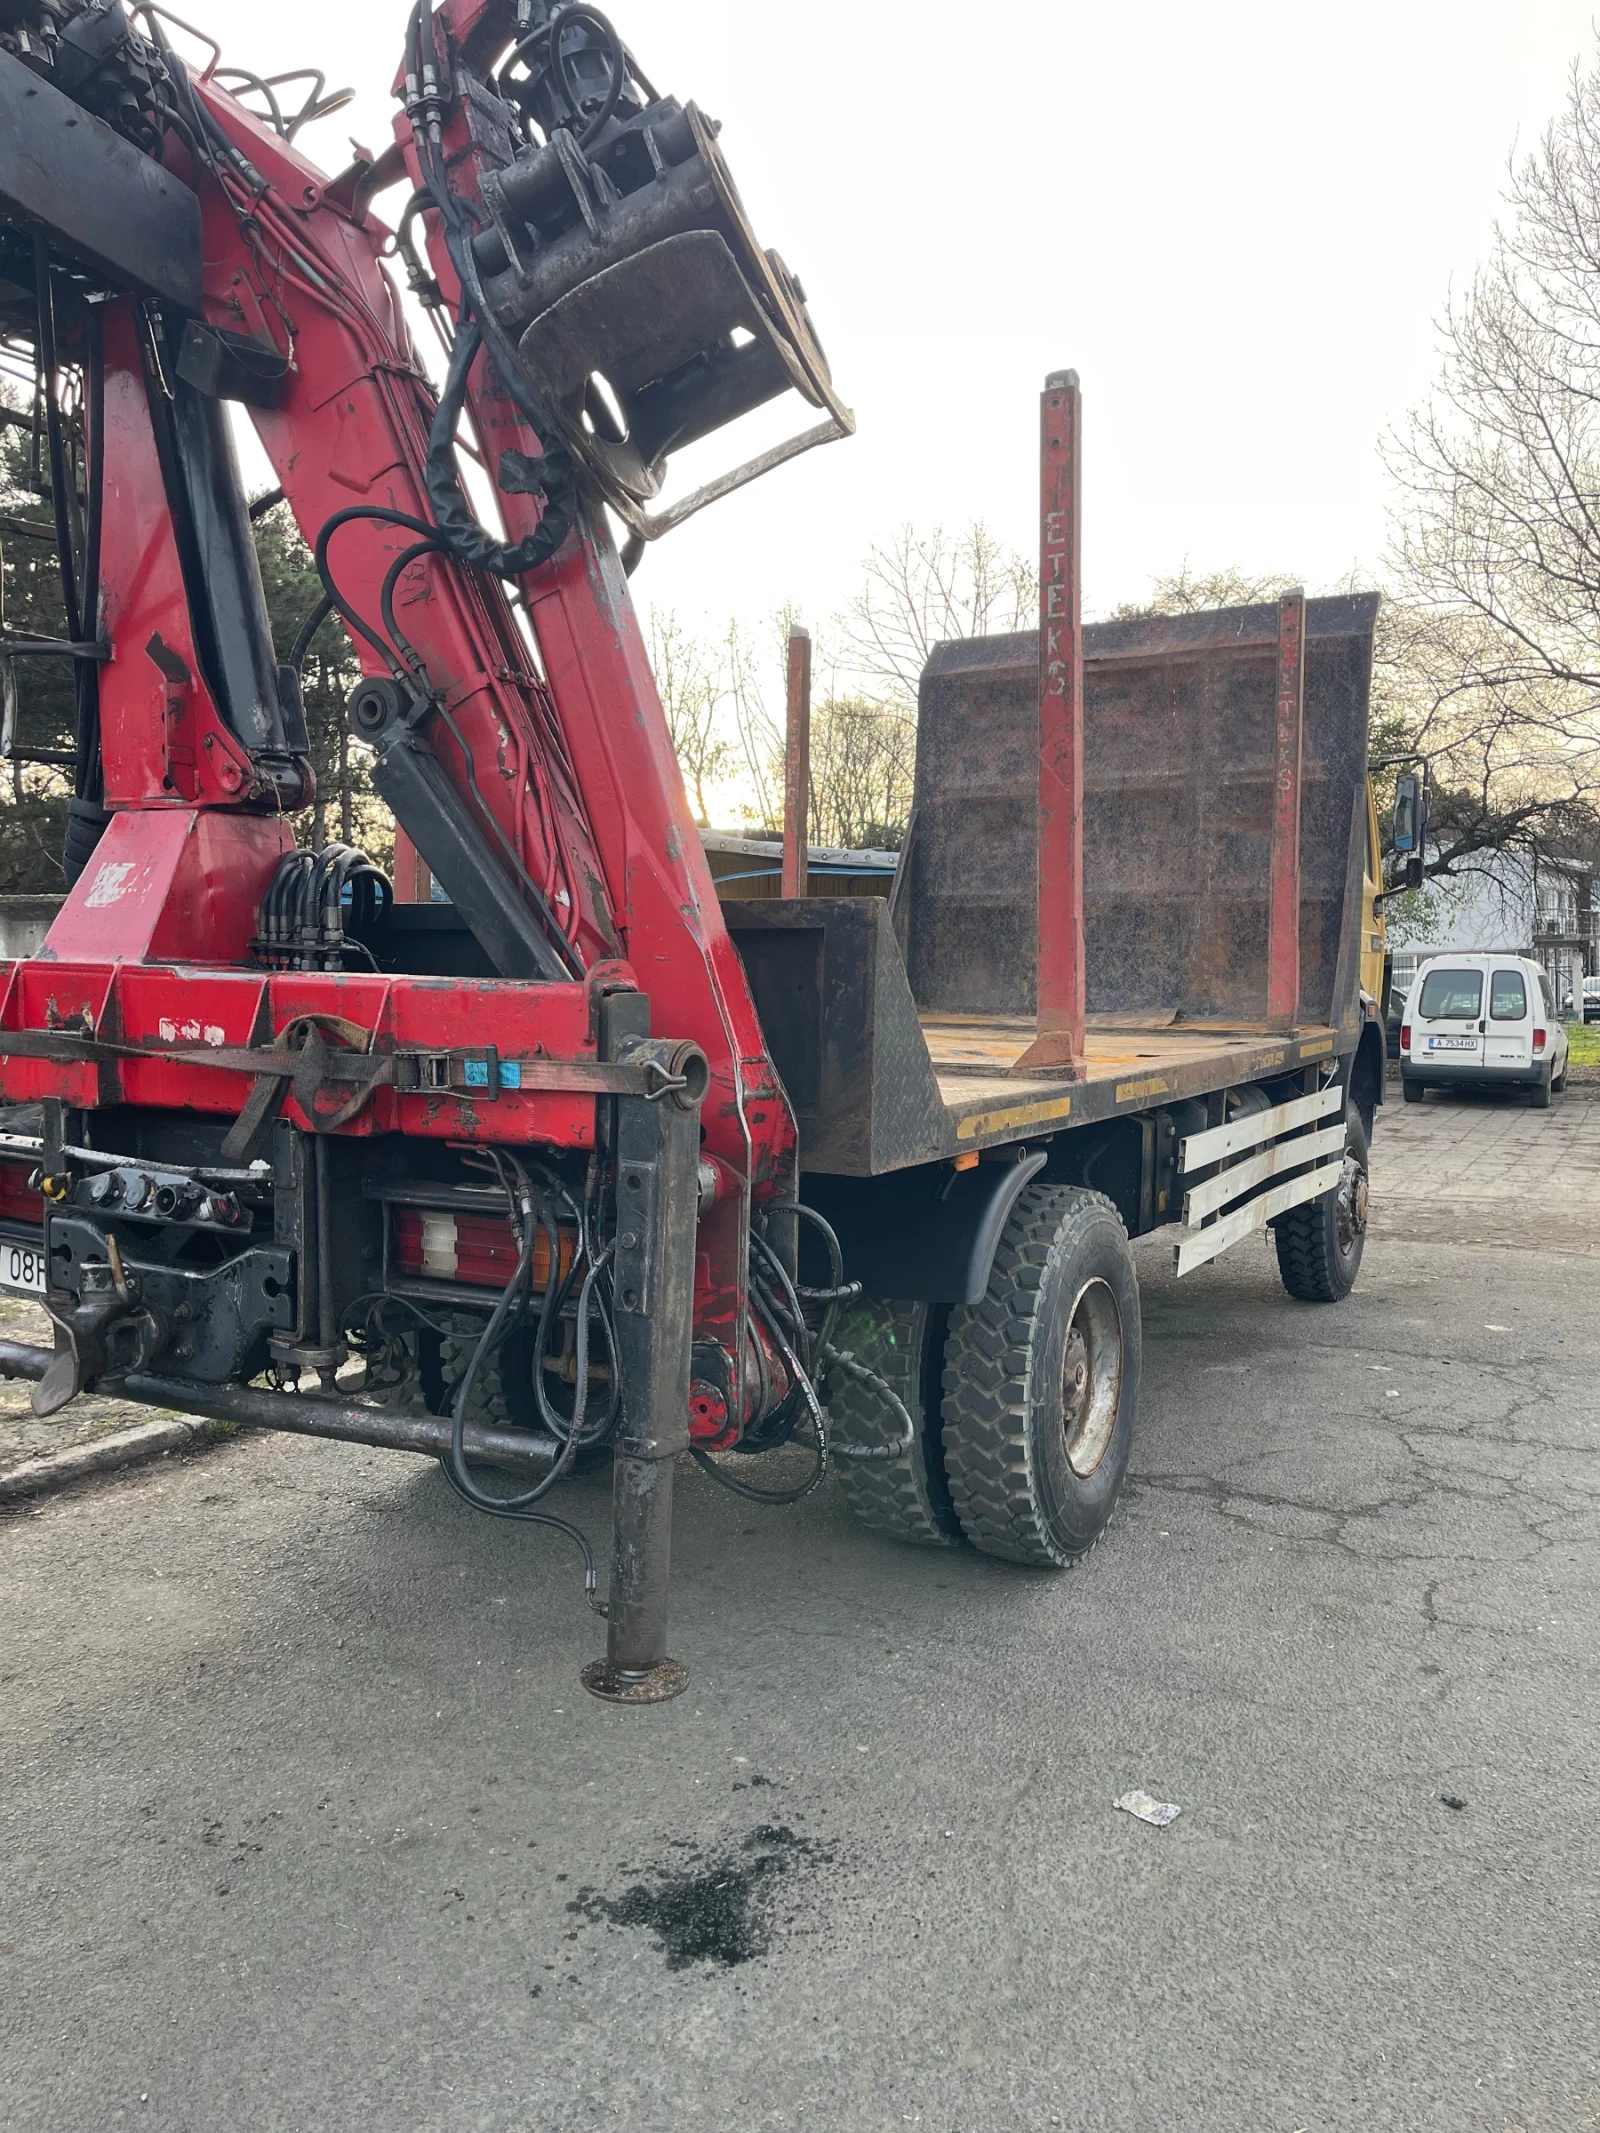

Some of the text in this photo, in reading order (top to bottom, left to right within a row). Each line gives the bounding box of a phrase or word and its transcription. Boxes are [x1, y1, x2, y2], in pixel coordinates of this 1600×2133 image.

[1436, 1039, 1476, 1048] A 7534 HX
